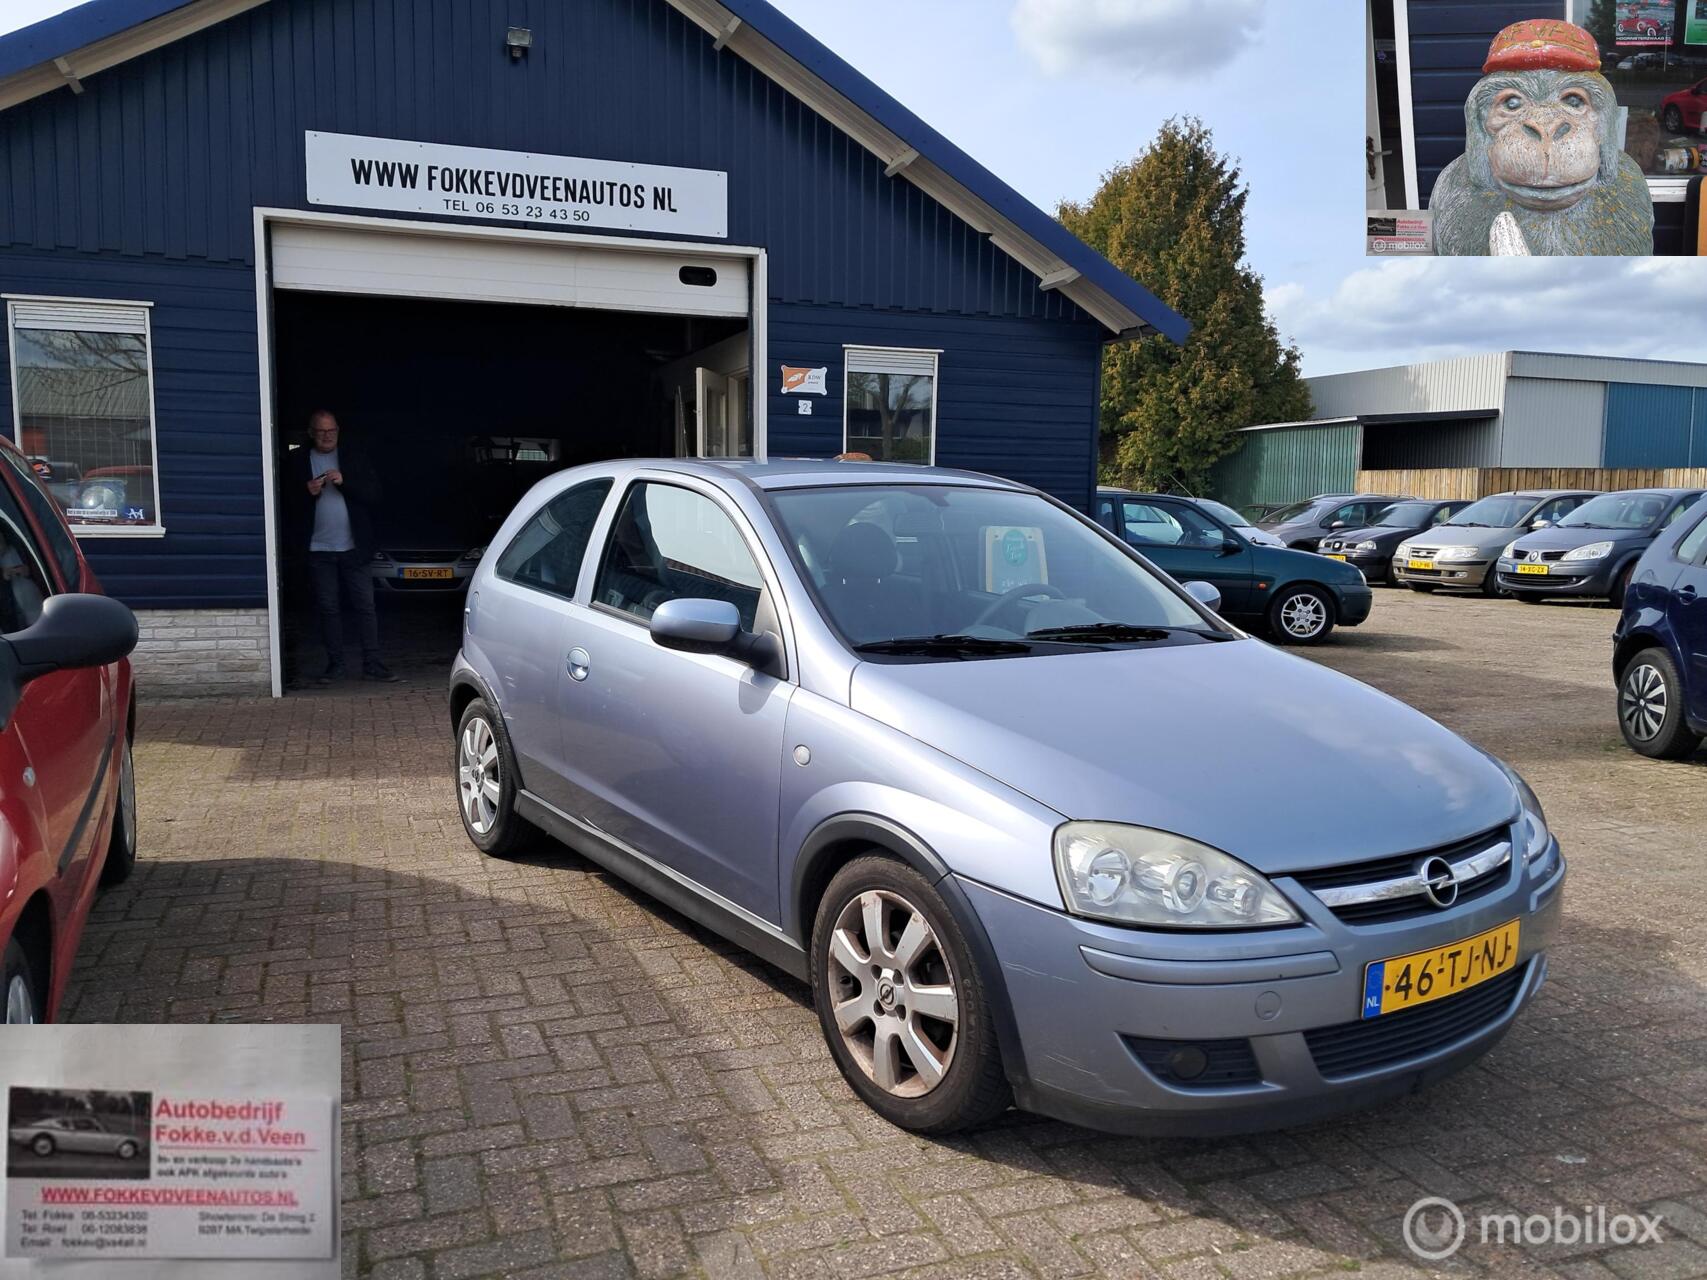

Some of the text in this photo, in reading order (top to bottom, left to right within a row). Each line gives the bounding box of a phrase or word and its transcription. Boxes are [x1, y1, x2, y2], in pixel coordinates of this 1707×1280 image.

[350, 157, 678, 213] WWW FOKKEVDVEENAUTOS NL
[442, 197, 591, 222] TEL 06 53 23 43 50
[408, 569, 449, 578] 16-SV-RT
[1394, 931, 1511, 1001] 46-TJ-NJ
[1366, 996, 1380, 1009] NL
